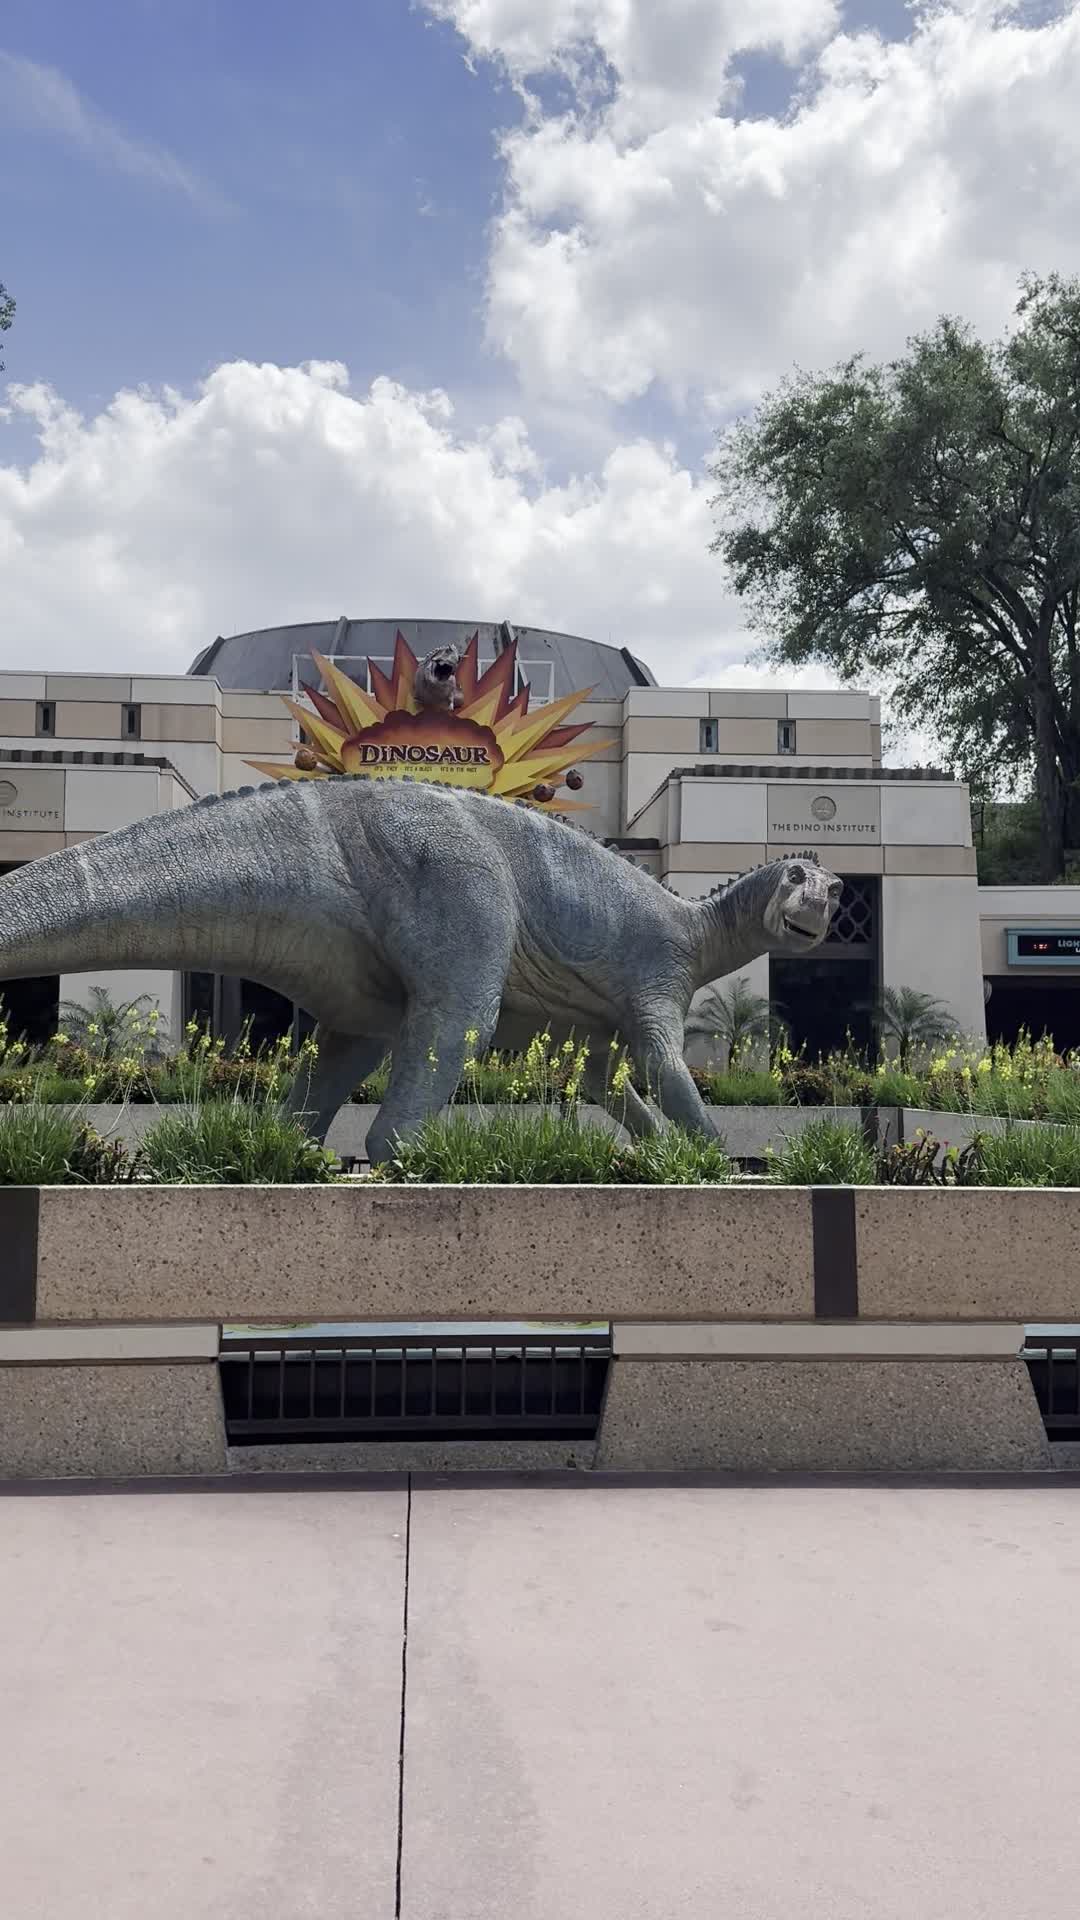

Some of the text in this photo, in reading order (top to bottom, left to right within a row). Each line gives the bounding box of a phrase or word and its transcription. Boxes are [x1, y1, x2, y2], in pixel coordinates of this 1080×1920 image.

[360, 744, 490, 764] DINOSAUR
[772, 823, 876, 832] THE DINO INSTITUTE
